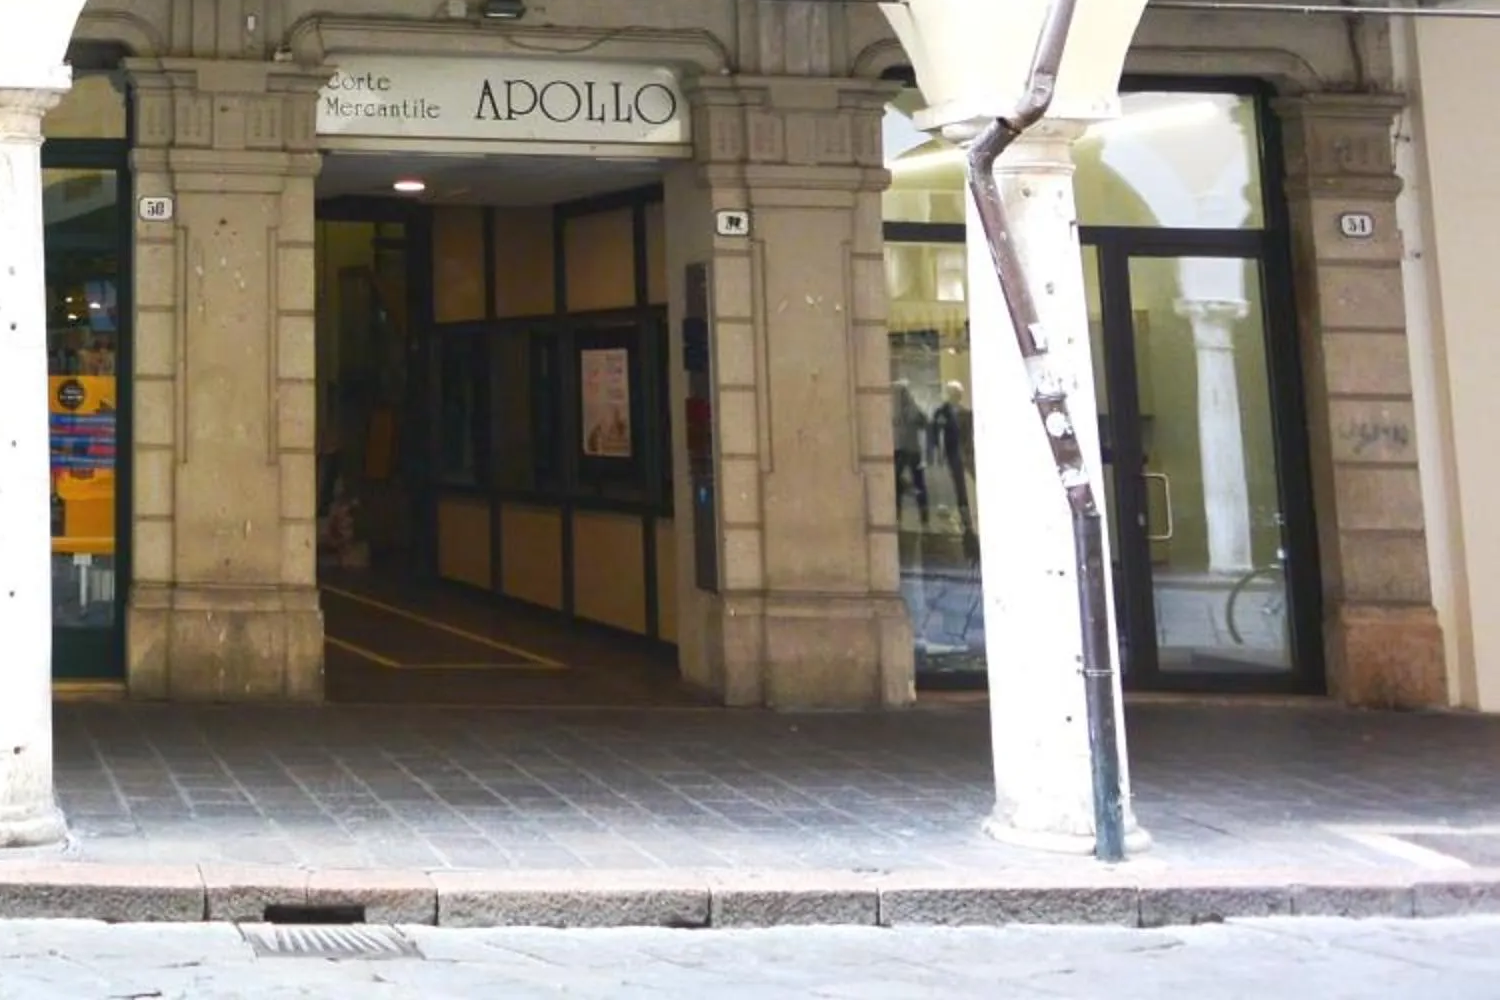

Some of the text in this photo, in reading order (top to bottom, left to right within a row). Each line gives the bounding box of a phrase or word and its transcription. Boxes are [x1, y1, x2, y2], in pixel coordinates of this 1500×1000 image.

[327, 71, 392, 91] Corte
[326, 97, 441, 119] Mercantile
[474, 79, 677, 125] APOLLO
